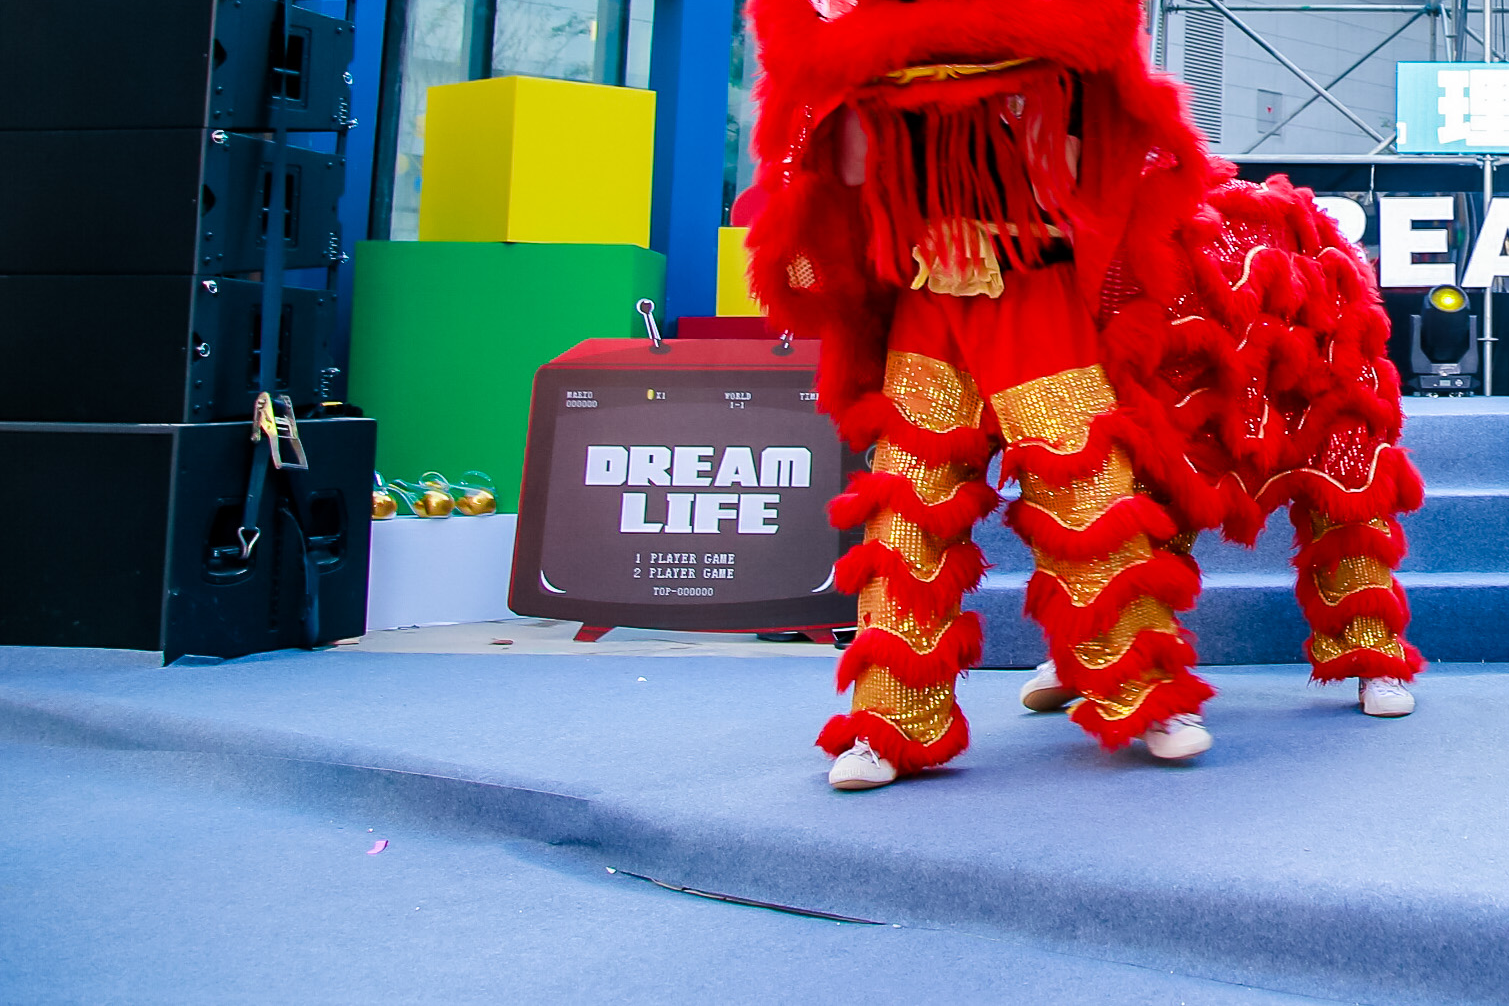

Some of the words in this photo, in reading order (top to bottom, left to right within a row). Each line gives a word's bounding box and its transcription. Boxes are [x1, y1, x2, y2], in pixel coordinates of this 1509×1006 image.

[724, 392, 752, 401] WORLD
[584, 445, 813, 488] DREAM
[620, 492, 781, 535] LIFE
[649, 553, 698, 564] PLAYER
[704, 553, 736, 565] GAME
[633, 567, 642, 578] 2
[648, 567, 697, 579] PLAYER
[703, 568, 735, 579] GAME
